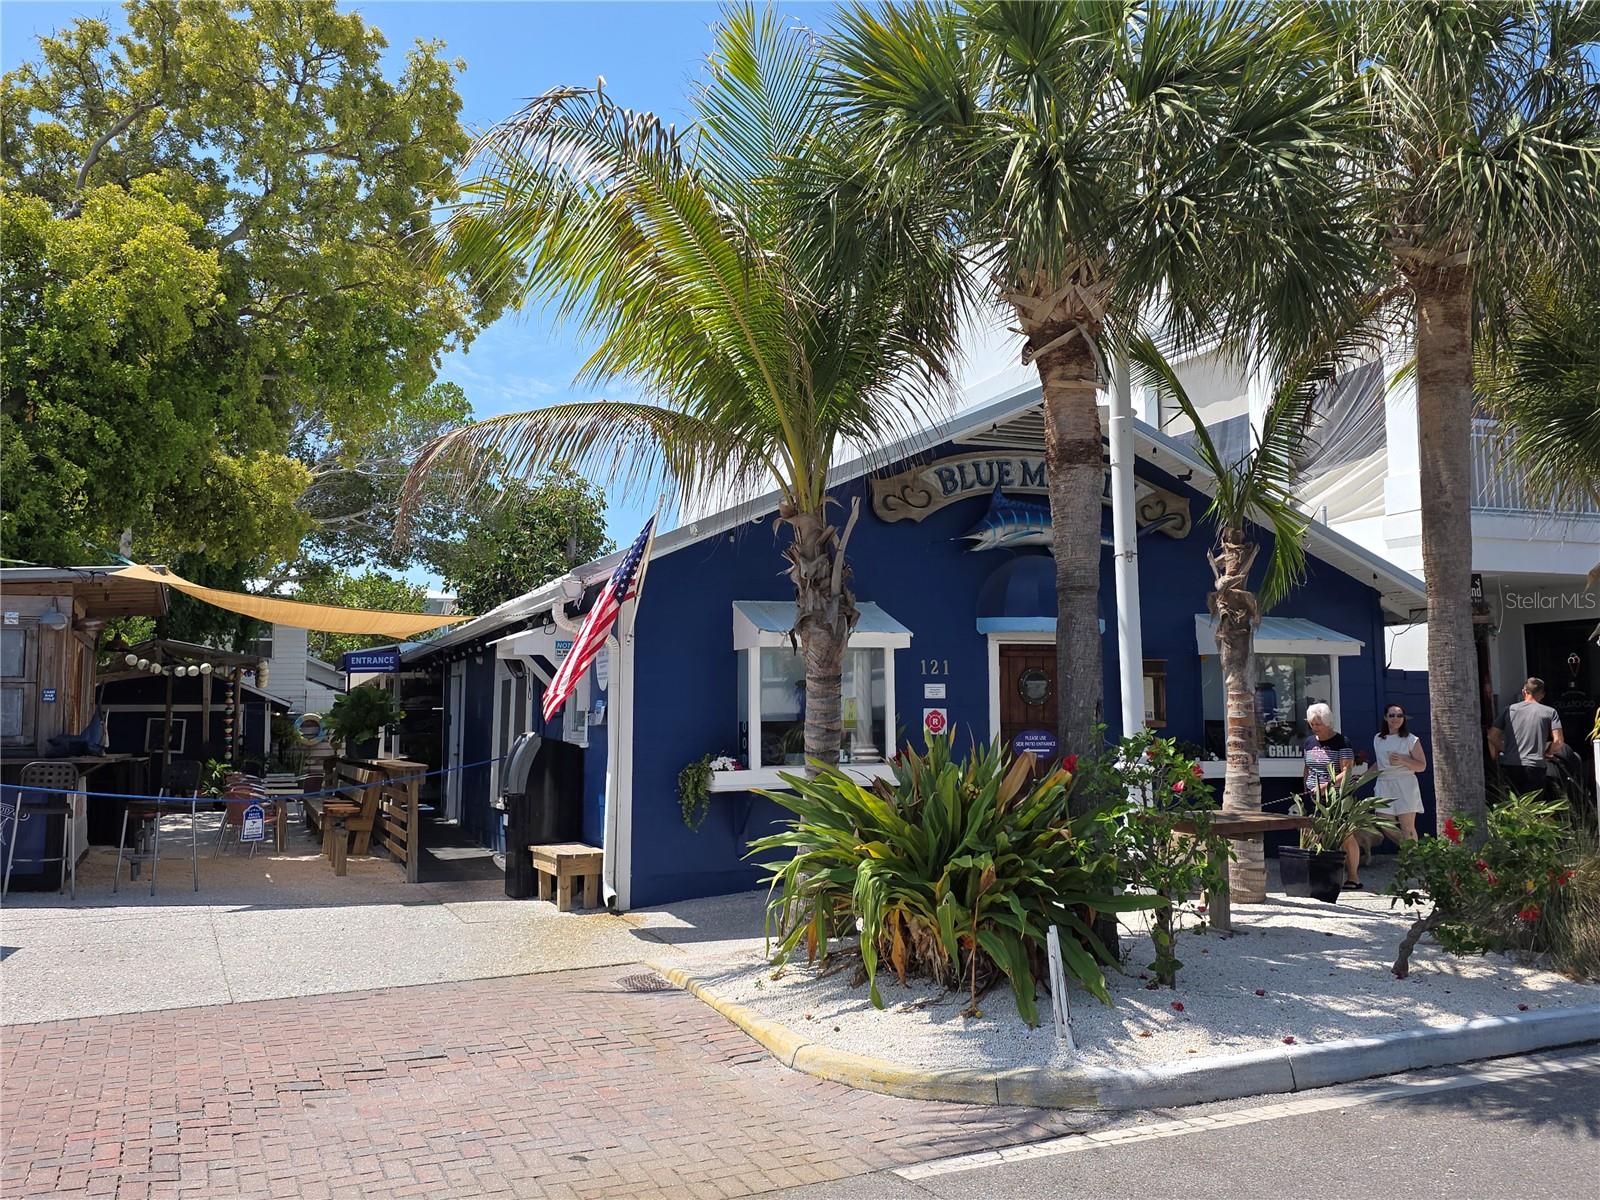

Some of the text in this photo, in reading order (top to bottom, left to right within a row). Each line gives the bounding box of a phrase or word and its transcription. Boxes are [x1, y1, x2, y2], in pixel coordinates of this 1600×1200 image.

[934, 459, 1015, 497] BLUE
[351, 656, 395, 665] ENTRANCE
[921, 659, 949, 675] 121
[1268, 745, 1303, 757] GRILL
